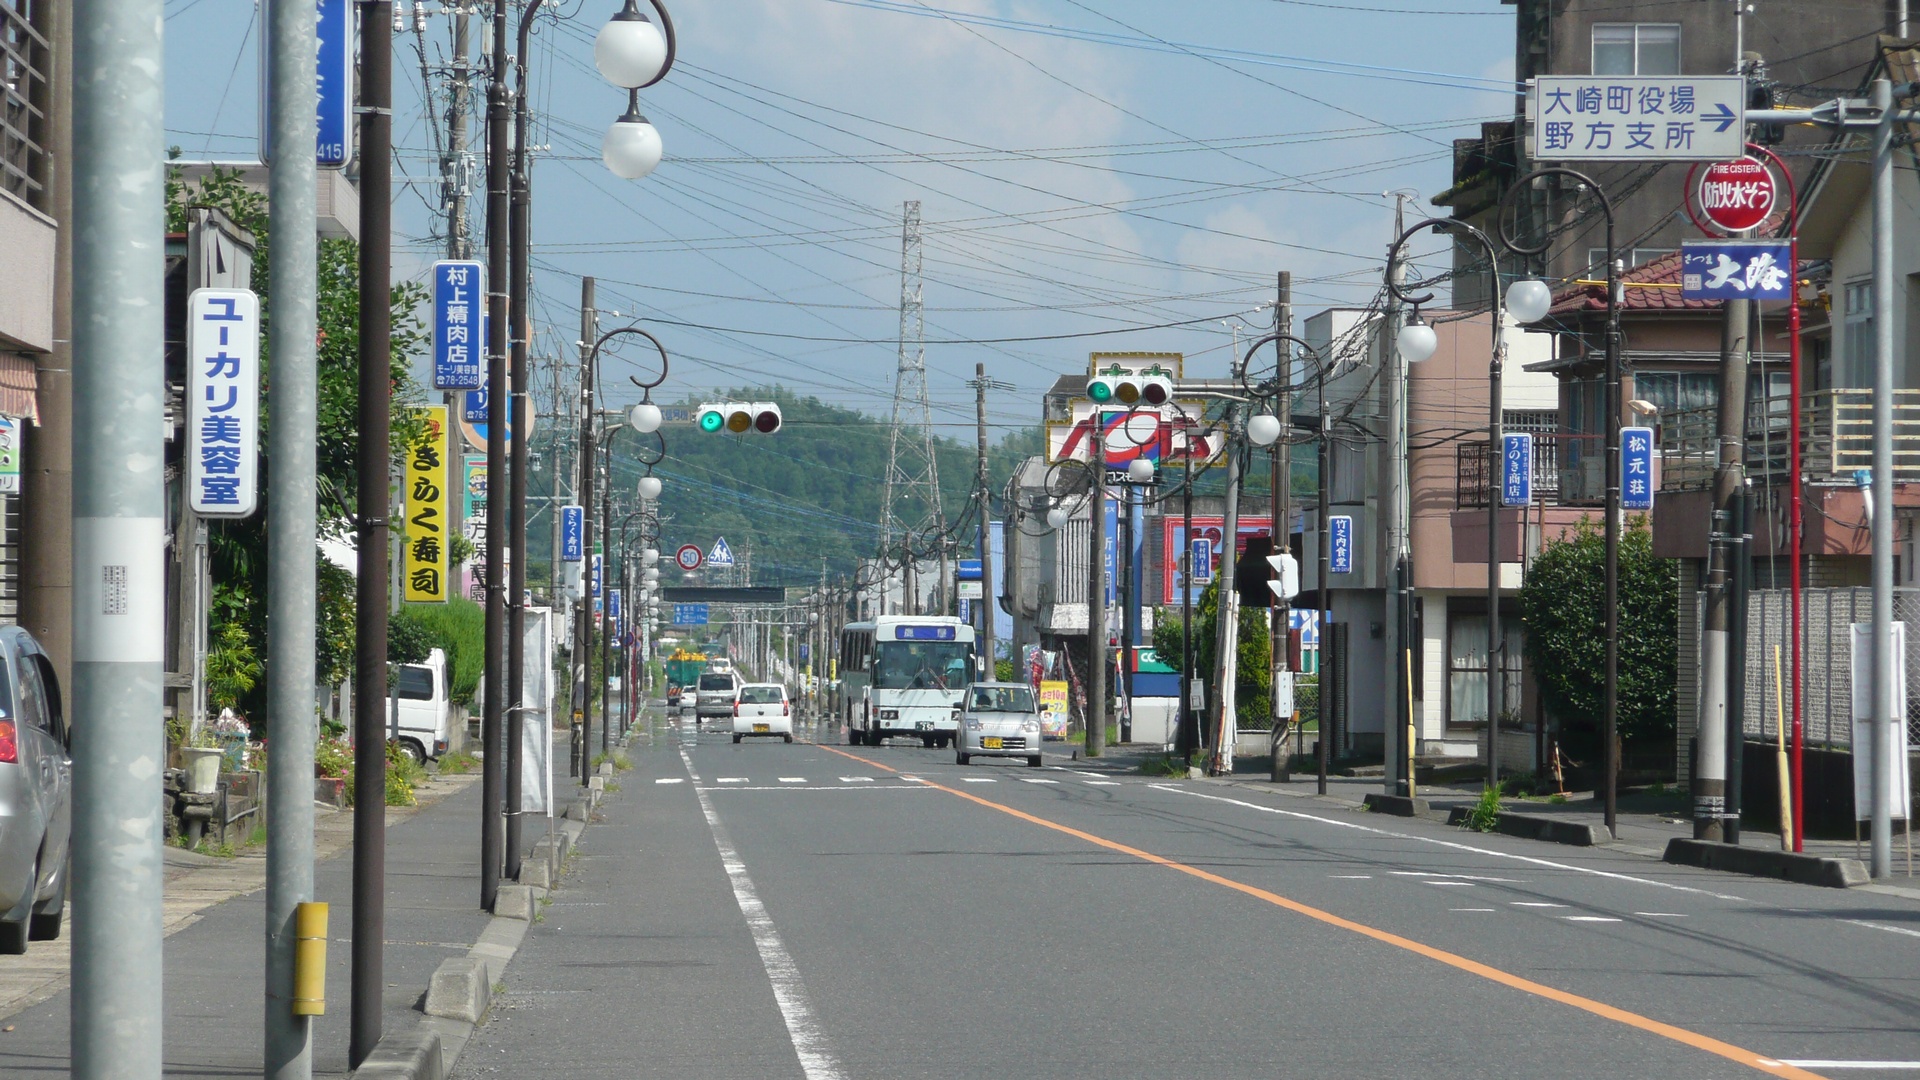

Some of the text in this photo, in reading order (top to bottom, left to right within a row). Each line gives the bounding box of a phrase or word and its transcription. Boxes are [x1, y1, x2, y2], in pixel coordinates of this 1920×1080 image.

[1544, 85, 1696, 115] 大崎町役場
[1544, 121, 1696, 150] 野方支所
[1713, 164, 1761, 174] FIRE CISTERN
[1704, 181, 1771, 209] 防火水そう
[1684, 253, 1714, 265] さつま
[446, 266, 469, 364] 村上精肉店
[436, 364, 479, 375] モーリ美容室
[445, 375, 479, 386] 78-2548
[200, 298, 244, 505] ユーカリ美容室
[1508, 438, 1521, 497] うのき商店
[1628, 435, 1647, 496] 松元荘
[411, 440, 441, 596] きらく寿司
[567, 508, 577, 555] きらく寿司
[682, 551, 697, 564] 50
[1335, 519, 1347, 567] 竹之内食堂
